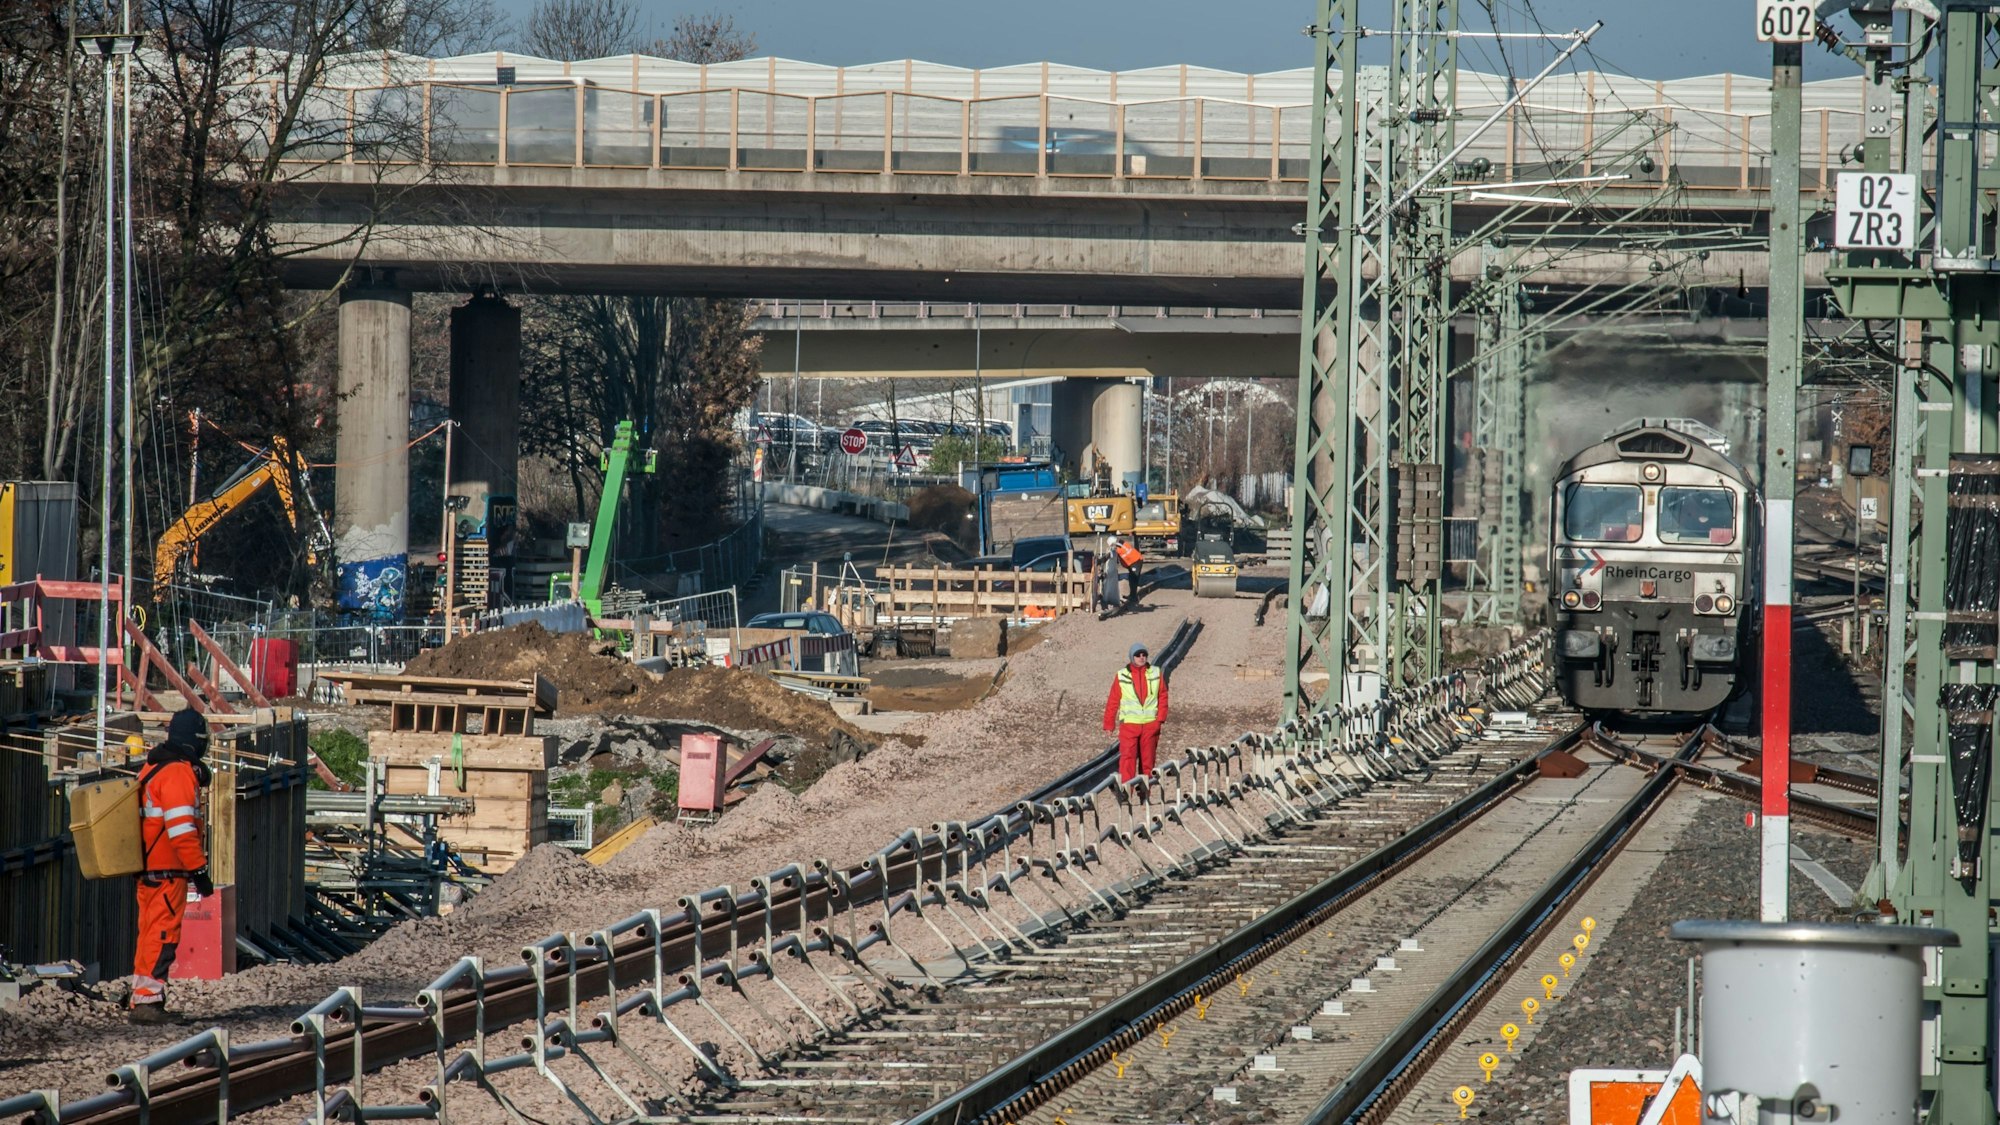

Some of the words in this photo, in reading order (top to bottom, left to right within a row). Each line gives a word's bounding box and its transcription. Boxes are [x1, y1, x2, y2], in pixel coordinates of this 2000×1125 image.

[1762, 6, 1811, 36] 602
[1848, 211, 1902, 246] ZR3
[843, 435, 865, 448] STOP
[1087, 505, 1109, 519] CAT
[1605, 565, 1692, 583] RheinCargo
